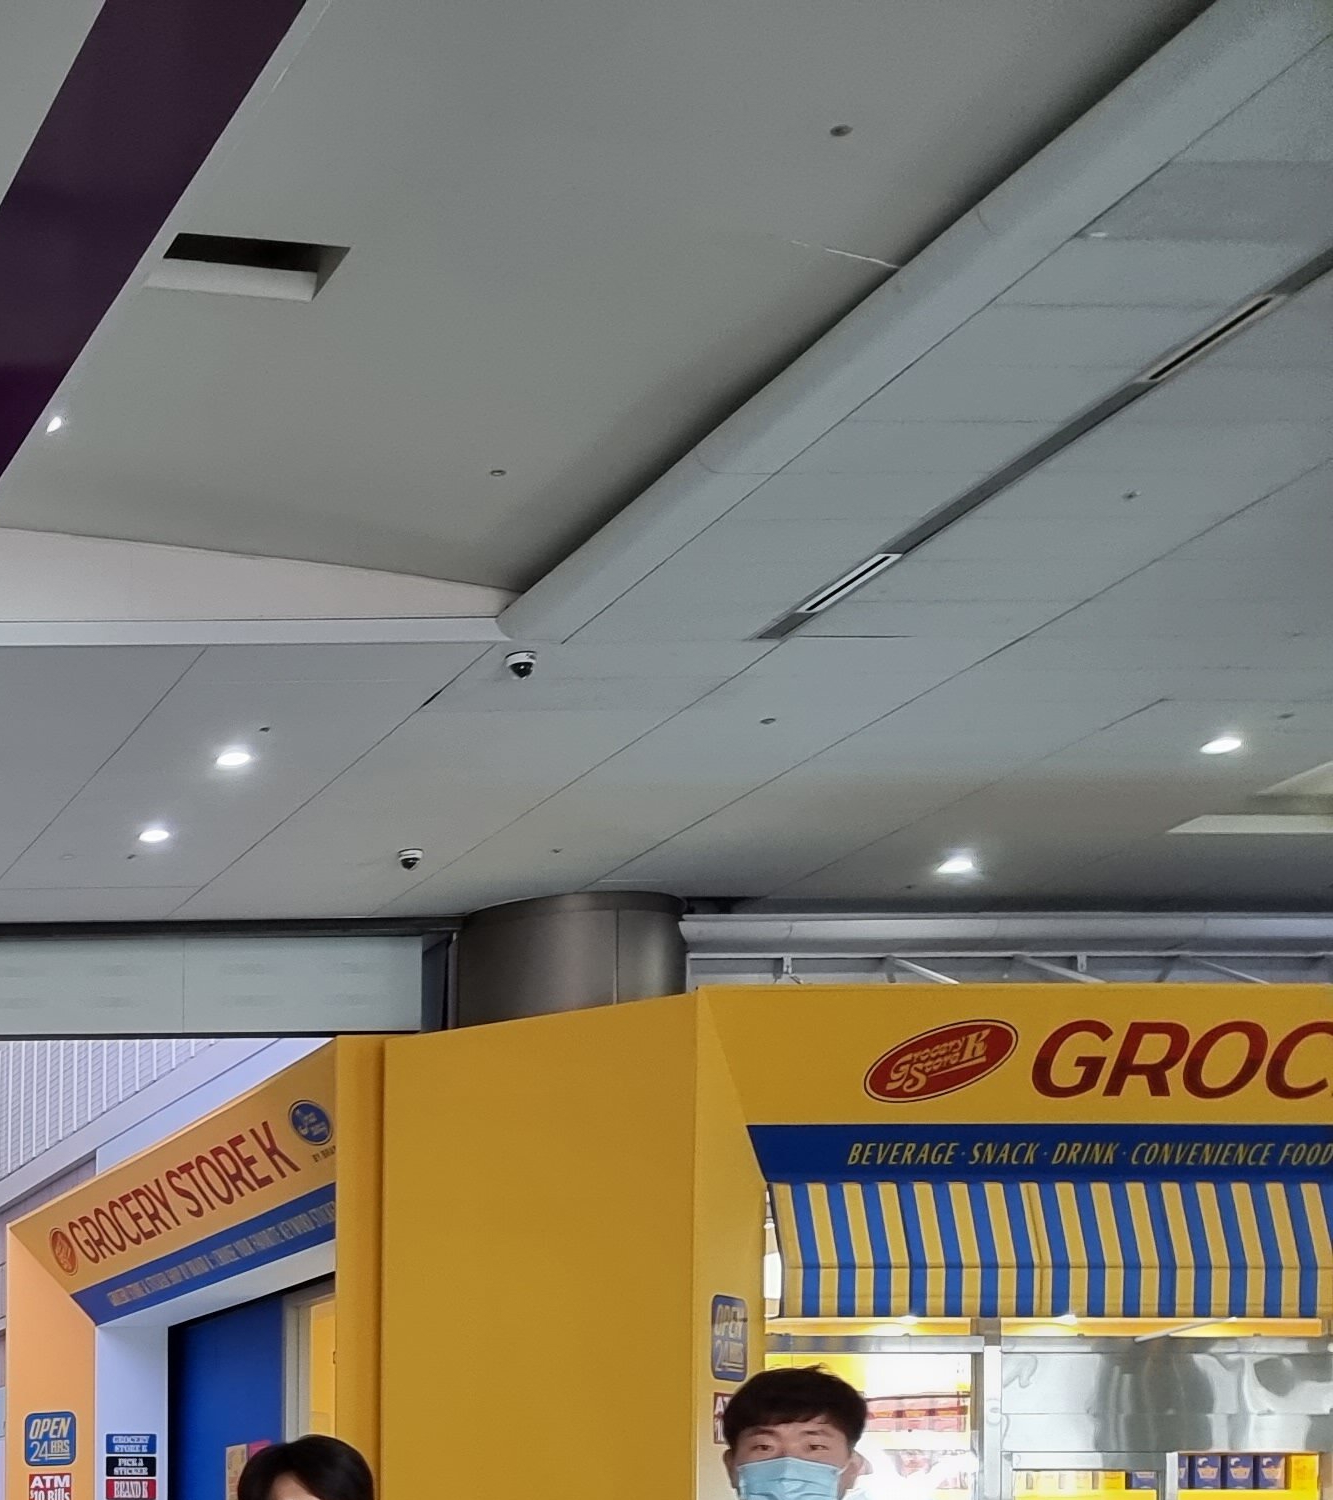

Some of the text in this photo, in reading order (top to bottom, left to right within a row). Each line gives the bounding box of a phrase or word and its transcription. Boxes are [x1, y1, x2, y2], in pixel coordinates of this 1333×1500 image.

[847, 1142, 1333, 1167] BEVERAGE SNACK DRINK CONVENIENCE FOOD
[67, 1178, 182, 1264] GROCERY
[165, 1133, 275, 1219] STORE
[248, 1120, 302, 1180] K
[29, 1416, 72, 1440] OPEN
[30, 1440, 70, 1462] 24 HRS
[30, 1475, 71, 1488] ATM
[113, 1481, 141, 1499] BRAND
